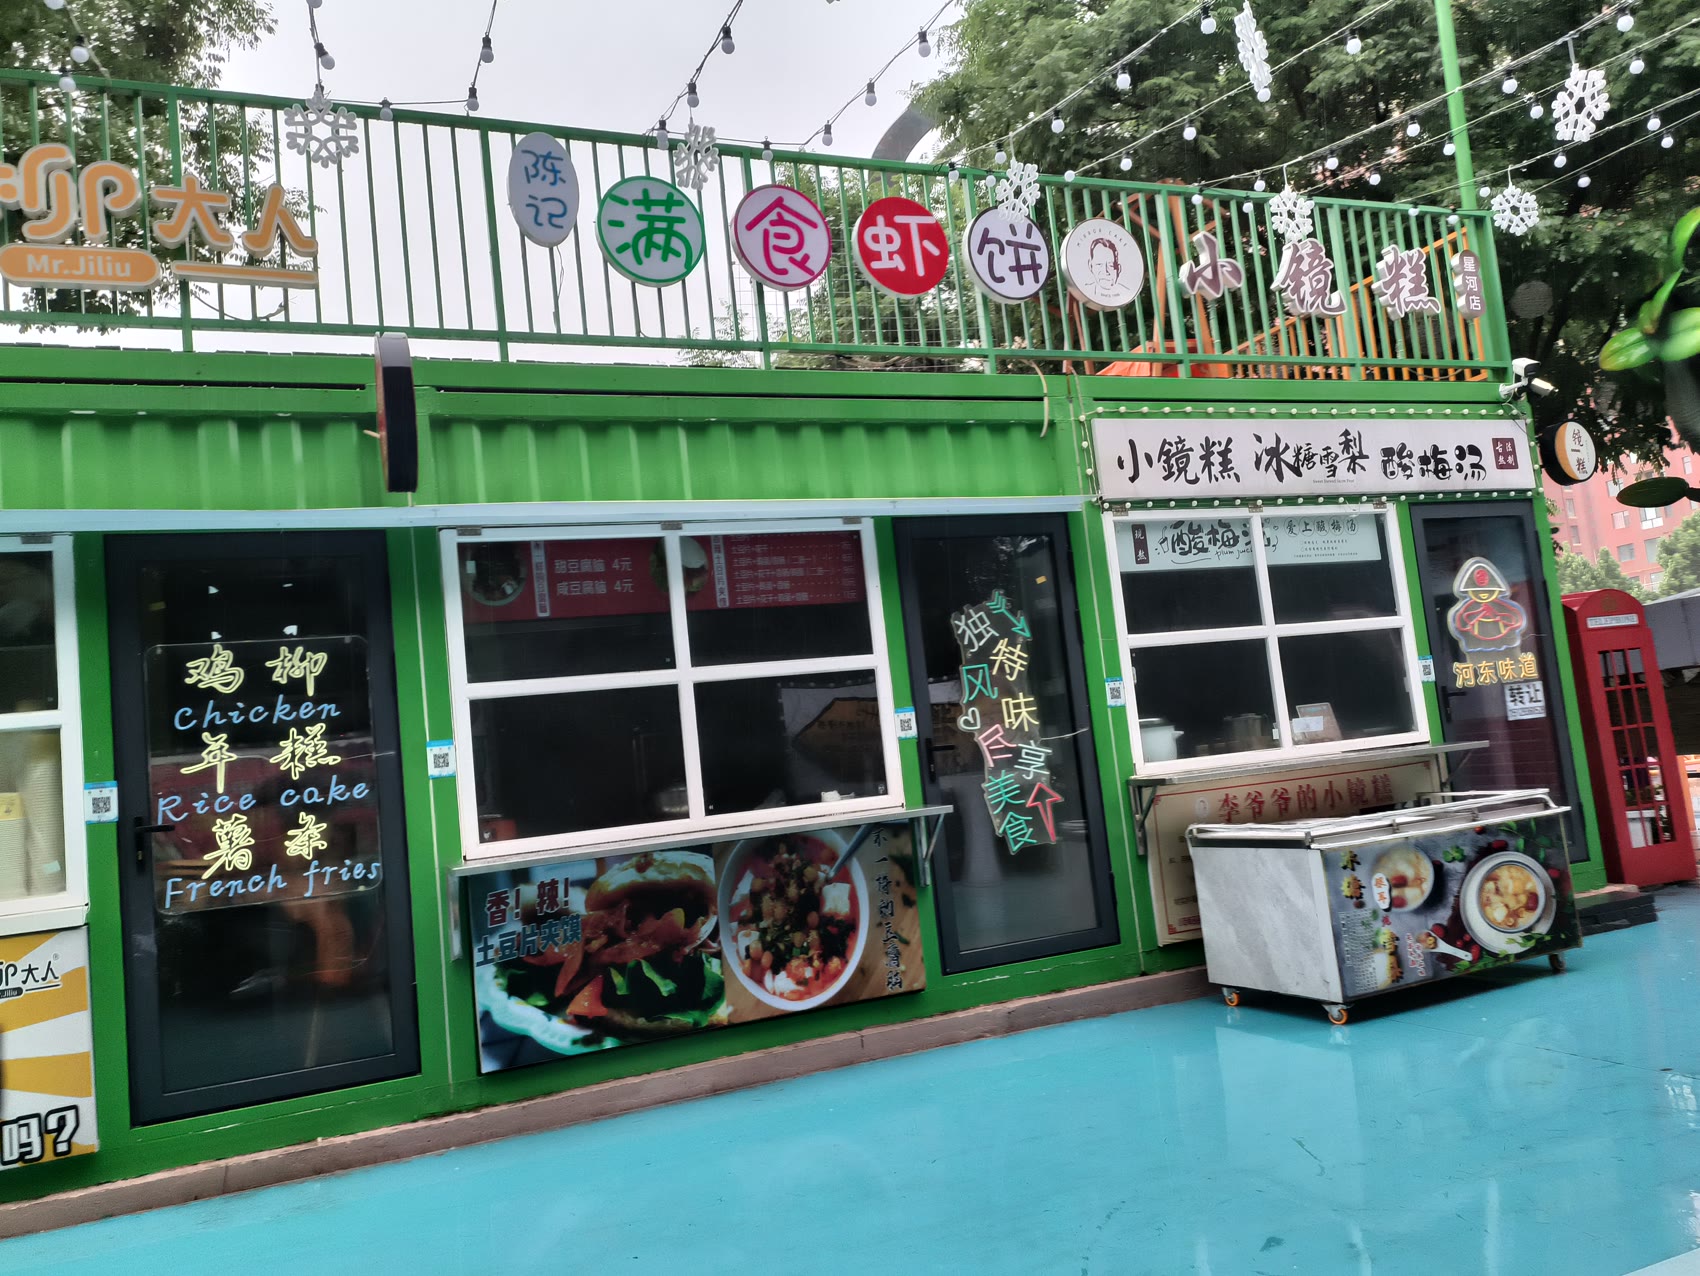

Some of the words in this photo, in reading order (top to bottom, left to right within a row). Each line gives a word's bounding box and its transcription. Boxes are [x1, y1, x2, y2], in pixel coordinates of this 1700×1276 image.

[520, 148, 568, 230] 陈记
[607, 188, 694, 271] 满
[745, 195, 819, 278] 食
[862, 214, 941, 278] 虾
[976, 222, 1043, 286] 饼
[26, 254, 132, 278] Mr.Jiliu
[1463, 255, 1482, 311] 星河店
[1252, 428, 1370, 484] 冰糖雪梨
[1380, 441, 1487, 481] 酸梅汤
[612, 557, 634, 571] 4元
[614, 578, 636, 593] 4元
[184, 643, 328, 697] 鸡柳
[1453, 652, 1539, 688] 河东味道
[1507, 684, 1543, 707] 转让
[173, 694, 341, 731] Chicken
[156, 791, 257, 825] Rice
[279, 774, 370, 807] cake
[202, 811, 328, 880] 薯条
[164, 863, 288, 909] French
[302, 859, 382, 898] fries
[474, 911, 583, 968] 土豆片夹馍
